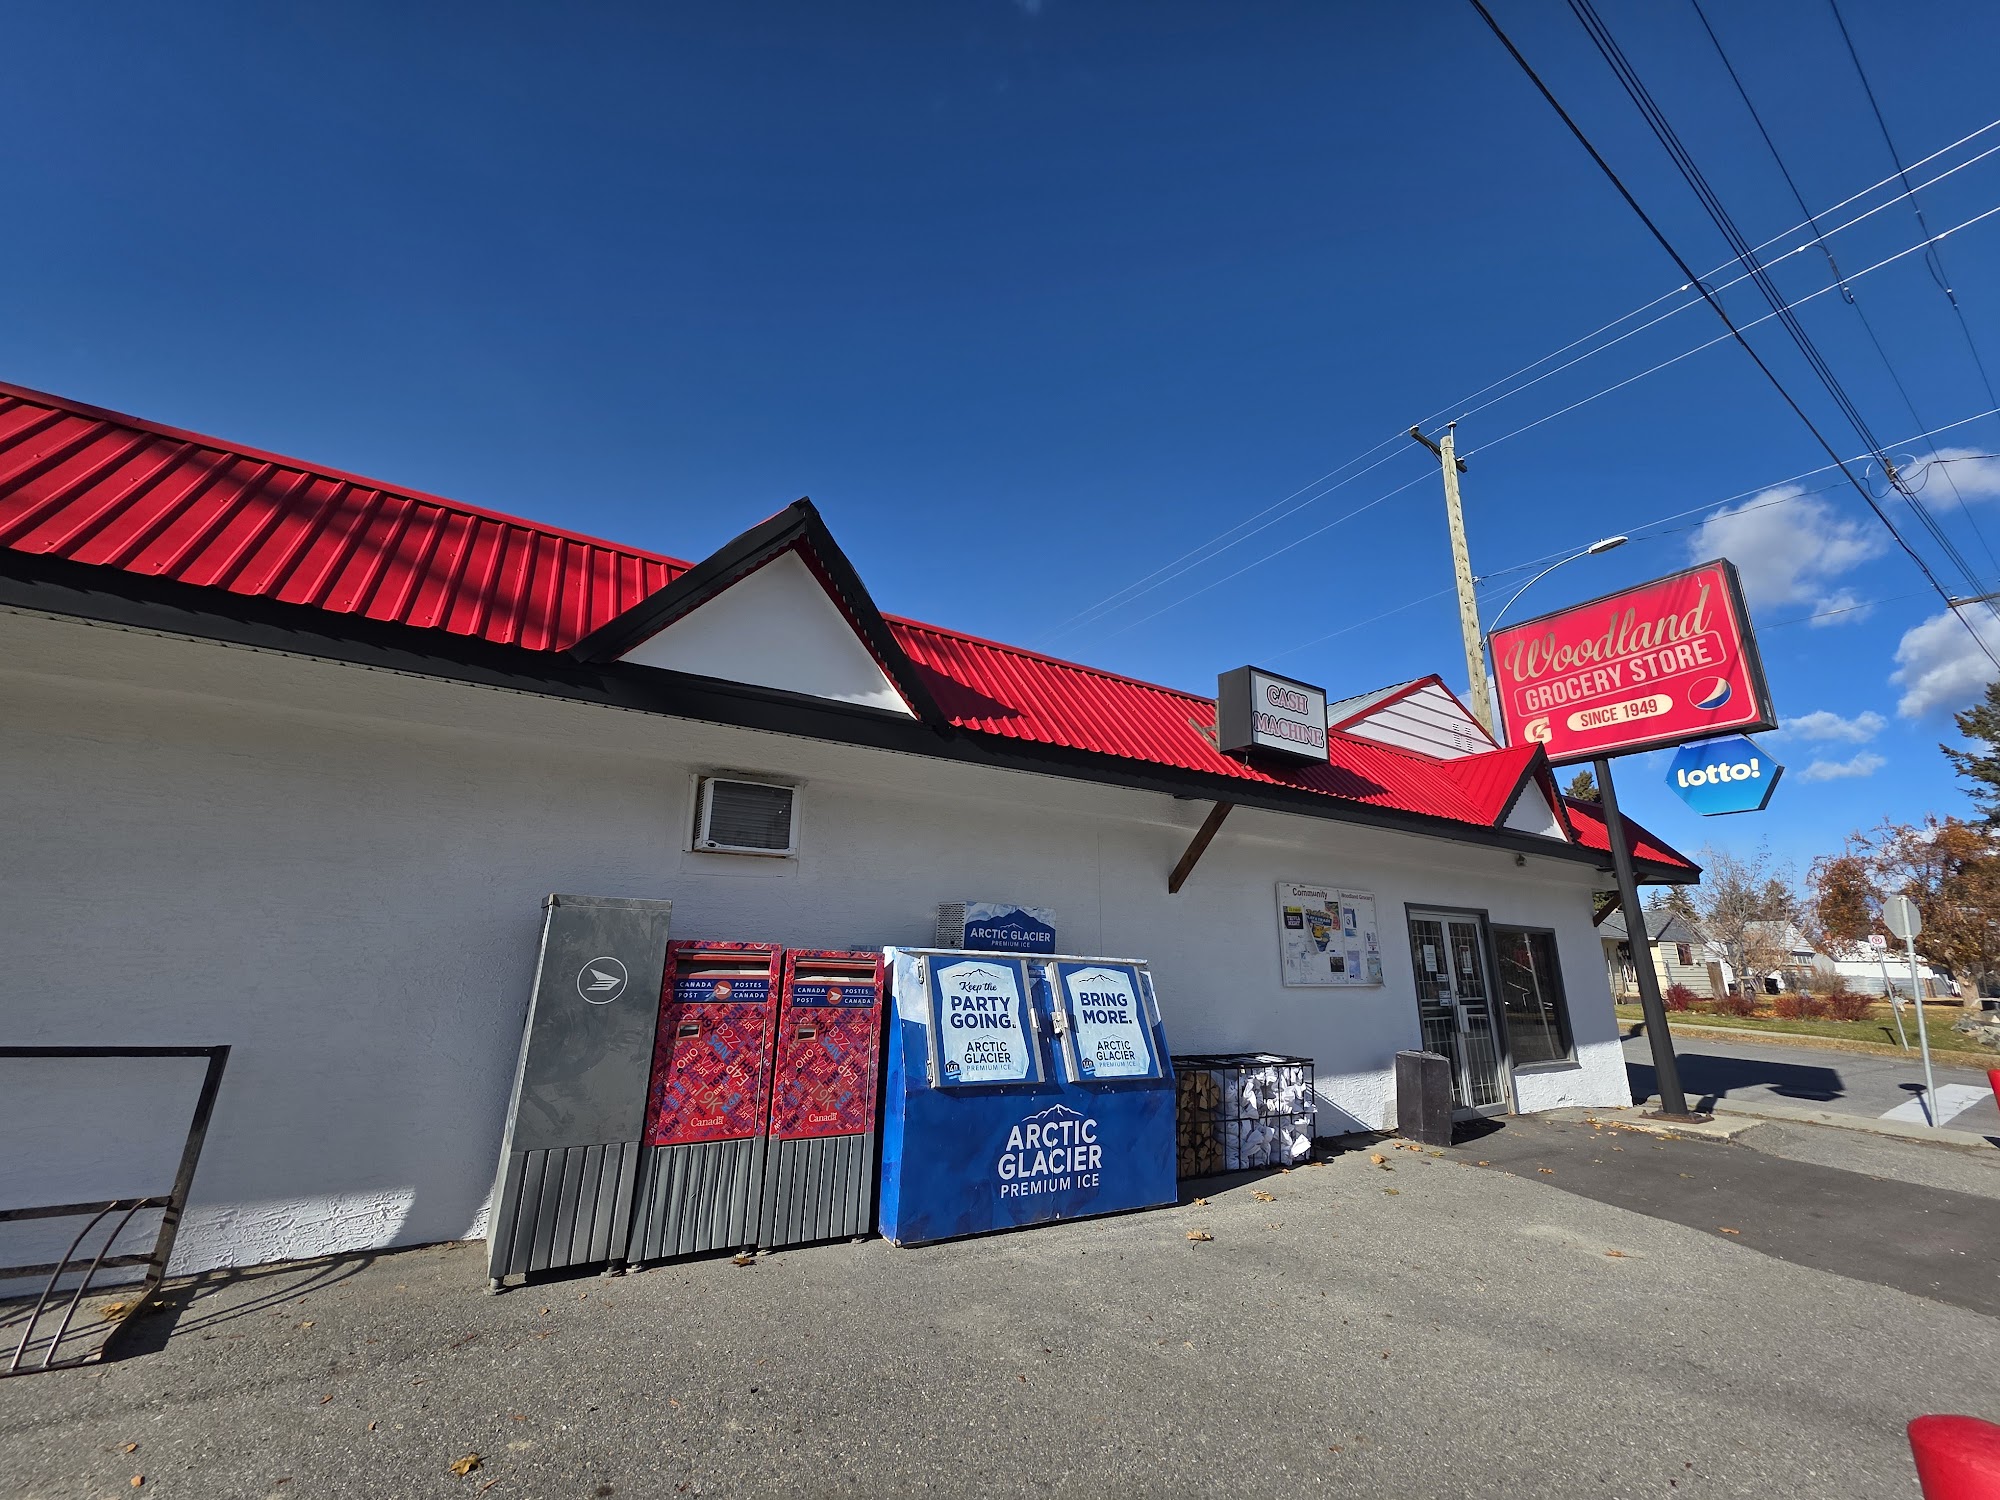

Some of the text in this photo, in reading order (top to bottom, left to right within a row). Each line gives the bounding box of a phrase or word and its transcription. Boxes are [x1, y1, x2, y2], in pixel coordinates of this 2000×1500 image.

[1505, 584, 1712, 682] Woodland
[1525, 638, 1712, 711] GROCERY STORE
[1267, 685, 1308, 715] CASH
[1580, 699, 1658, 727] SINCE 1949
[1253, 710, 1324, 748] MACHINE
[1677, 757, 1760, 788] lotto!
[1292, 887, 1328, 900] Community
[970, 927, 1051, 942] ARCTIC GLACIER
[959, 981, 997, 993] Keep the
[950, 995, 1011, 1012] PARTY
[1080, 992, 1128, 1007] BRING
[950, 1012, 1017, 1029] GOING.
[1082, 1010, 1133, 1024] MORE.
[707, 1034, 731, 1059] S4N
[716, 1023, 741, 1049] B2Z
[828, 1027, 851, 1050] B2Z
[966, 1041, 1008, 1053] ARCTIC
[1097, 1040, 1131, 1051] ARCTIC
[820, 1037, 842, 1059] S4N
[964, 1052, 1011, 1064] GLACIER
[1096, 1050, 1135, 1061] GLACIER
[708, 1070, 727, 1090] M9L
[725, 1062, 749, 1086] E4P
[822, 1070, 840, 1089] M9L
[837, 1062, 859, 1084] E4P
[692, 1083, 723, 1114] T9K
[808, 1081, 837, 1110] T9K
[690, 1116, 724, 1127] Canada
[808, 1113, 837, 1123] Canada
[1006, 1119, 1098, 1151] ARCTIC
[998, 1145, 1102, 1180] GLACIER
[1001, 1173, 1100, 1199] PREMIUM ICE
